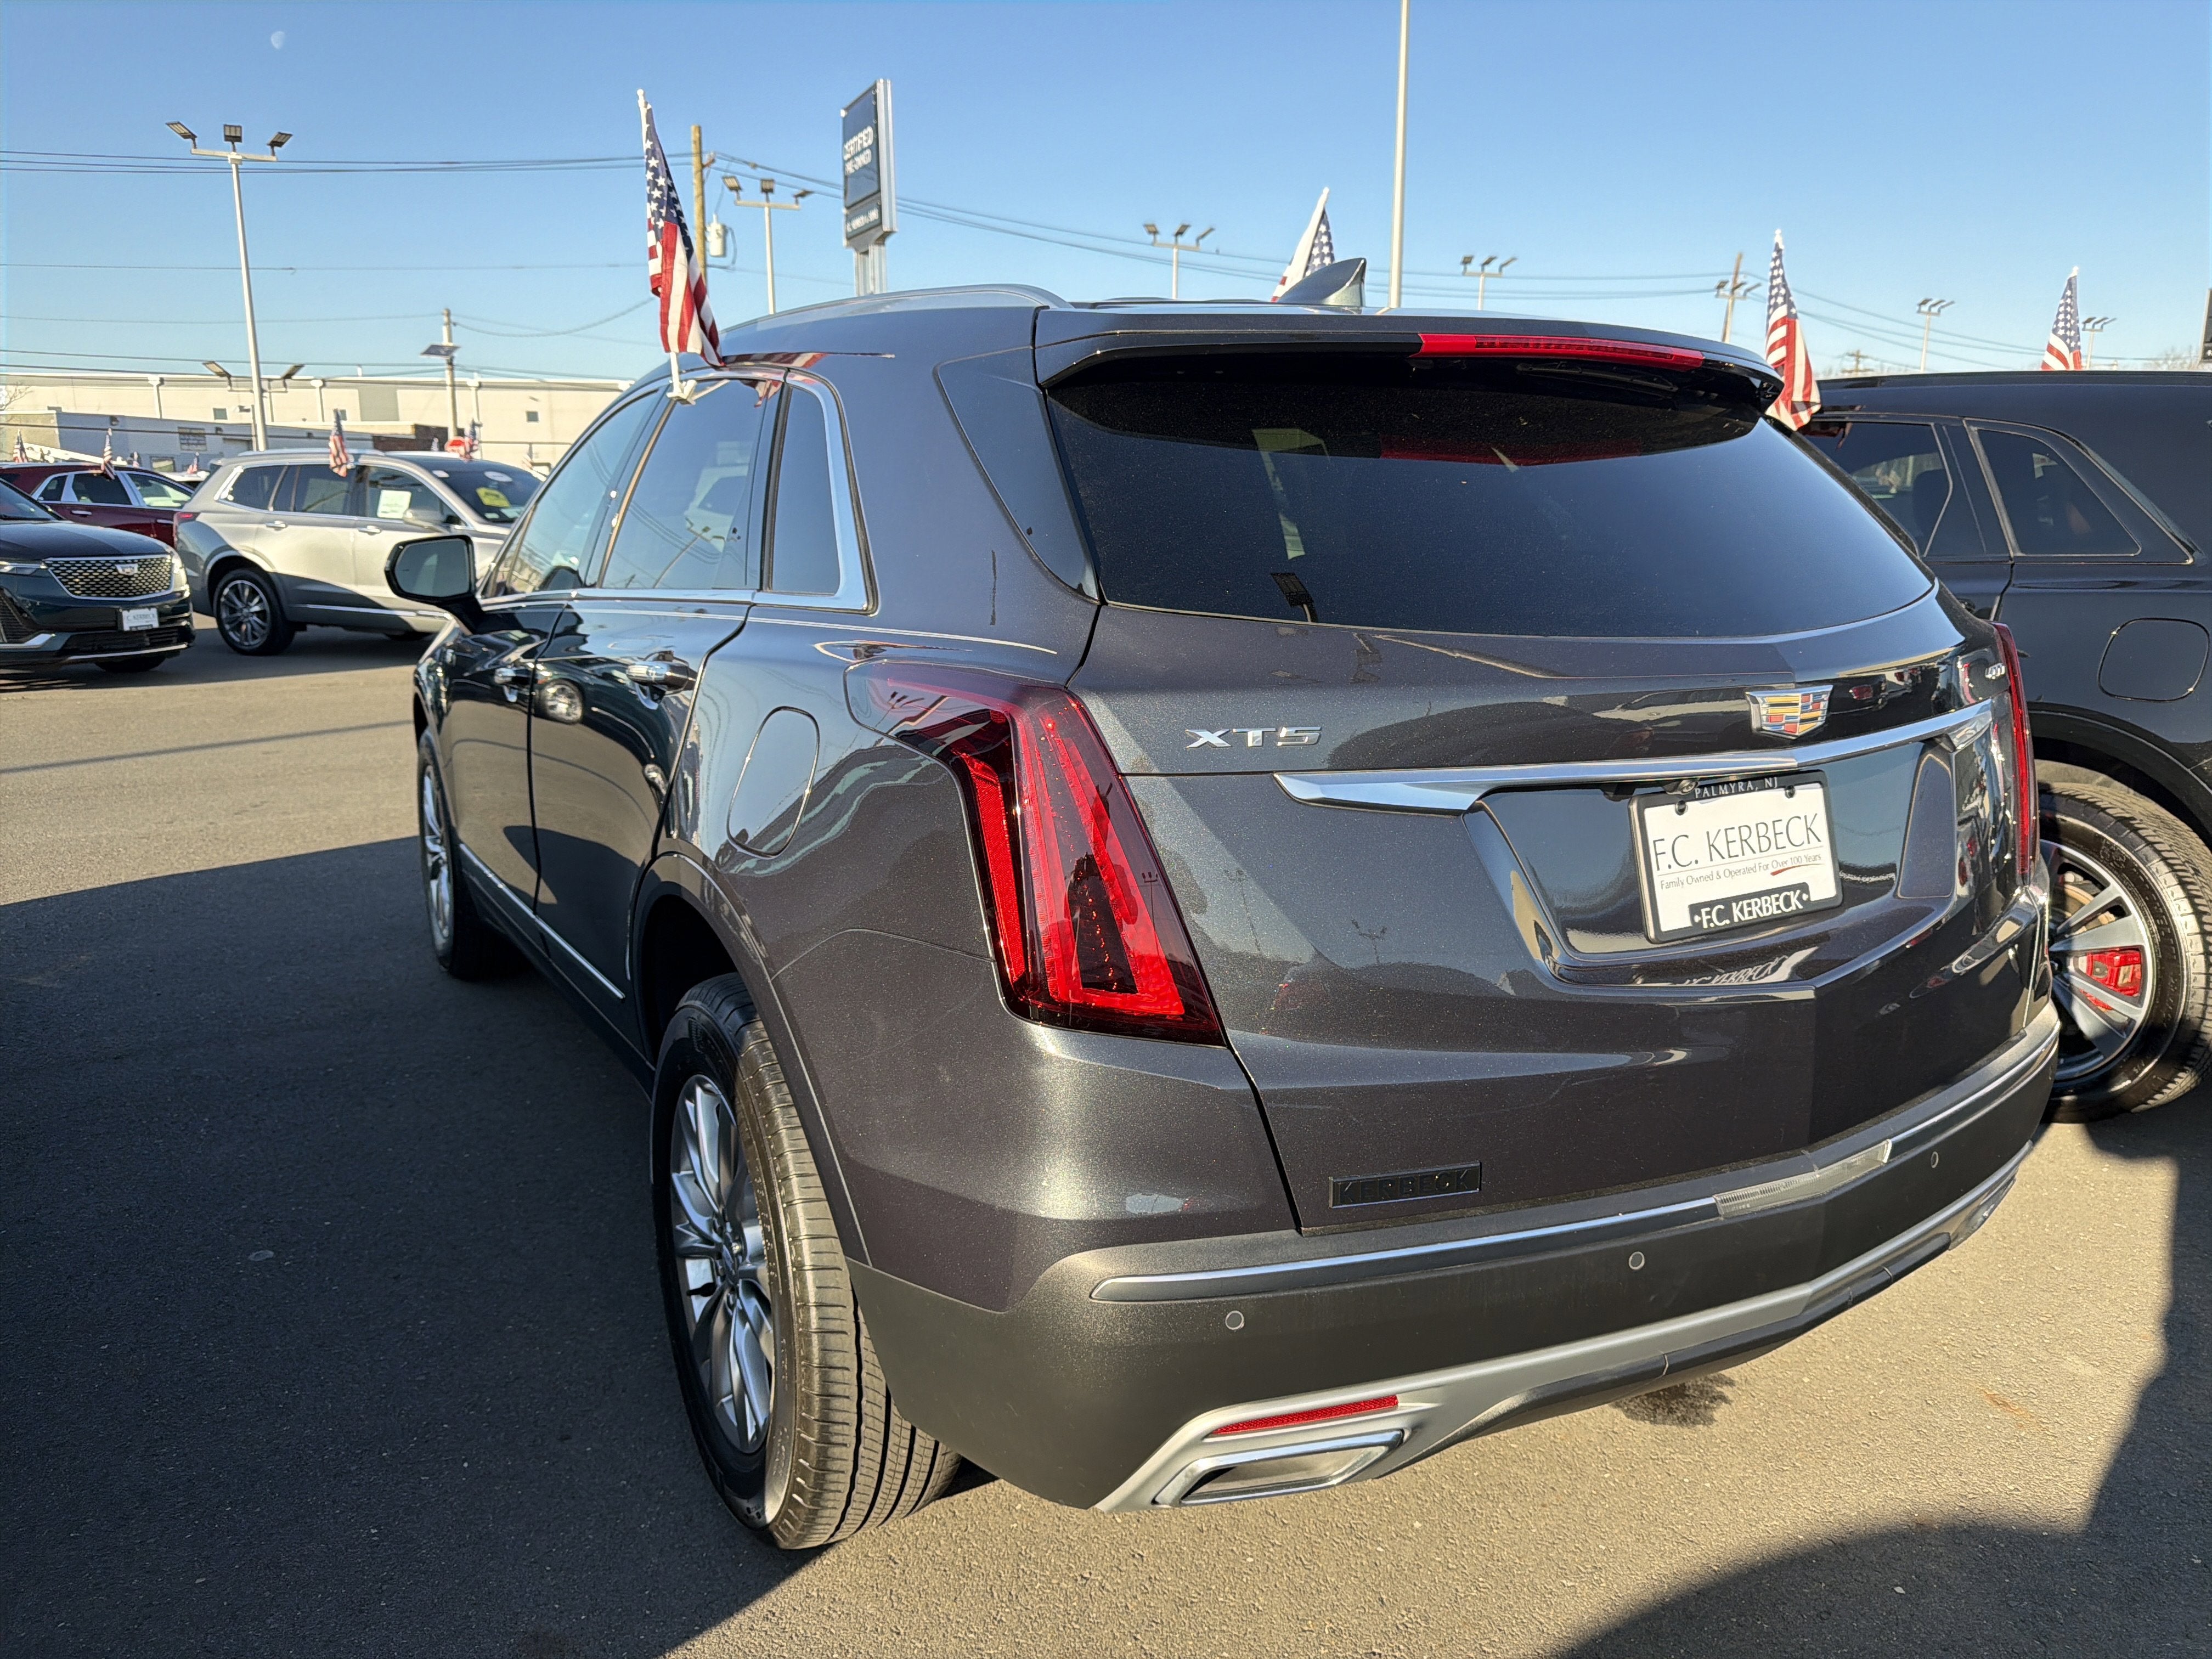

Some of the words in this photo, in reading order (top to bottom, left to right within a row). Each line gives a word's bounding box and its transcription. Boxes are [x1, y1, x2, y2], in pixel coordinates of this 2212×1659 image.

[1185, 726, 1322, 749] XT5
[1694, 780, 1758, 799] PALMYRA,
[1764, 776, 1778, 789] NJ
[1652, 834, 1699, 871] F.C.
[1706, 812, 1822, 862] KERBECK
[1660, 877, 1684, 889] Family
[1686, 871, 1714, 885] Owned
[1716, 870, 1722, 880] &
[1723, 863, 1757, 879] Operated
[1758, 862, 1769, 872] For
[1771, 860, 1788, 869] Over
[1790, 856, 1803, 865] 100
[1804, 854, 1821, 863] Years
[1701, 905, 1730, 929] F.C.
[1731, 889, 1804, 923] KERBECK
[1338, 1169, 1469, 1203] KERBECK
